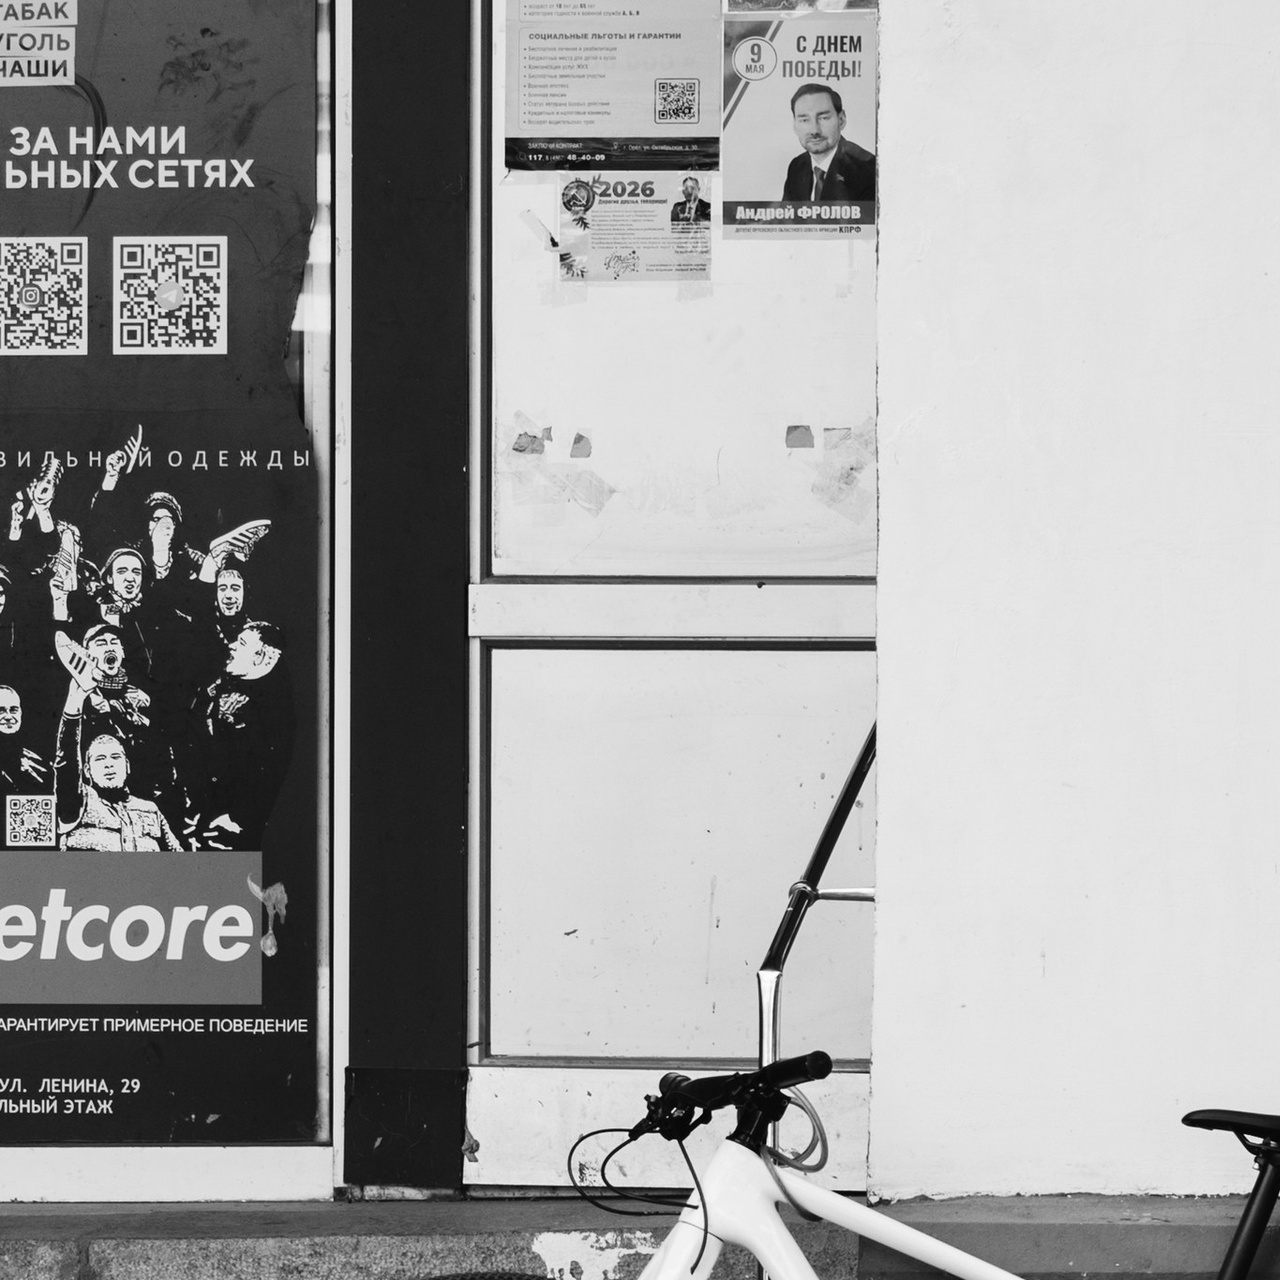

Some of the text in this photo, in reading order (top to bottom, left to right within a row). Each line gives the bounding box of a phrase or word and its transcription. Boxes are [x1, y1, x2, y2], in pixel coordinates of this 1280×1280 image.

[0, 34, 70, 51] ГОЛЬ
[796, 35, 862, 56] С ДНЕМ
[750, 43, 762, 63] 9
[745, 64, 764, 73] МАЯ
[782, 60, 862, 81] ПОБЕДЫ!
[9, 126, 187, 156] ЗА НАМИ
[5, 159, 256, 190] ЬНЫХ СЕТЯХ
[600, 181, 655, 198] 2026
[735, 205, 861, 221] Андрей ФРОЛОВ
[839, 226, 861, 234] КПРФ
[168, 451, 309, 470] ОДЕЖДЫ
[0, 888, 253, 962] etcore
[103, 1018, 205, 1033] ПРИМЕРНОЕ
[209, 1018, 308, 1034] ПОВЕДЕНИЕ
[38, 1079, 114, 1096] ЛЕНИНА,
[121, 1079, 141, 1093] 29
[63, 1099, 113, 1114] ЭТАЖ
